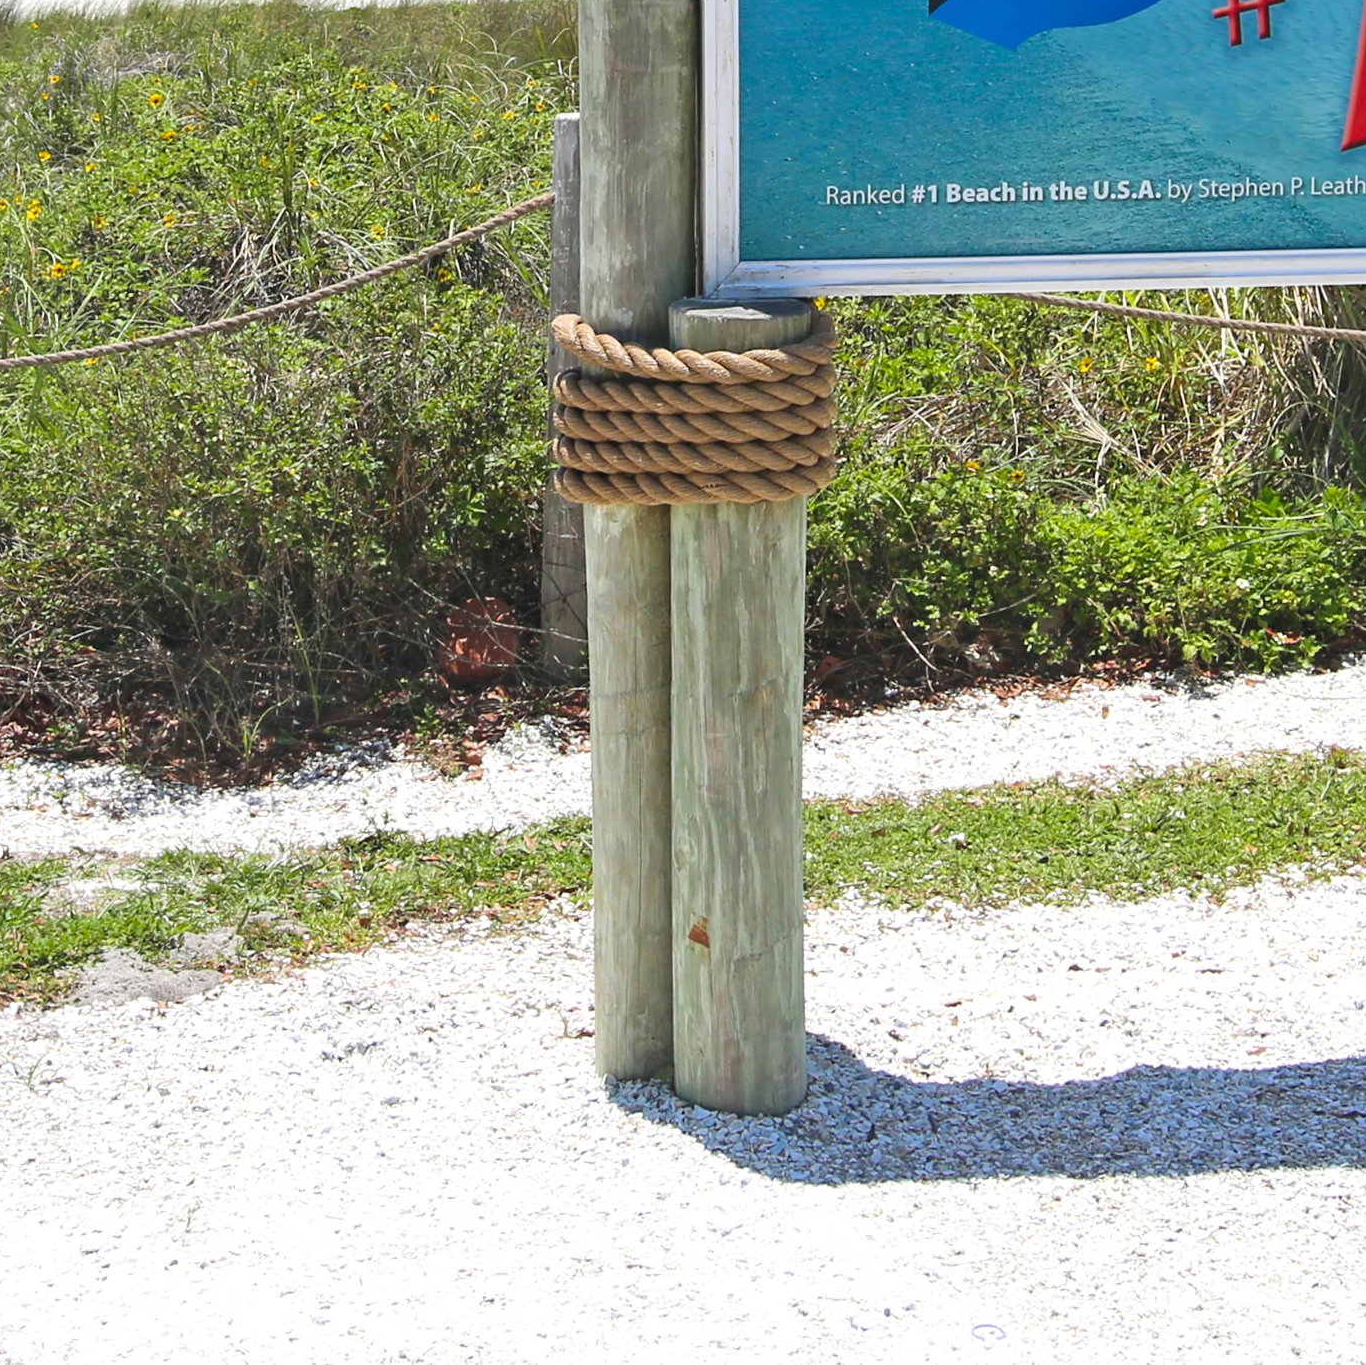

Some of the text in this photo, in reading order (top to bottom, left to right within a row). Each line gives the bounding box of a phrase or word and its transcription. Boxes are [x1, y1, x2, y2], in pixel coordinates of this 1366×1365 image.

[825, 183, 906, 206] Ranked
[912, 184, 939, 204] #1
[946, 181, 1017, 203] Beach
[1022, 181, 1044, 202] in
[1049, 180, 1087, 201] the
[1093, 179, 1162, 200] U.S.A.
[1167, 178, 1193, 203] by
[1198, 177, 1284, 202] Stephen
[1290, 177, 1305, 196] P.
